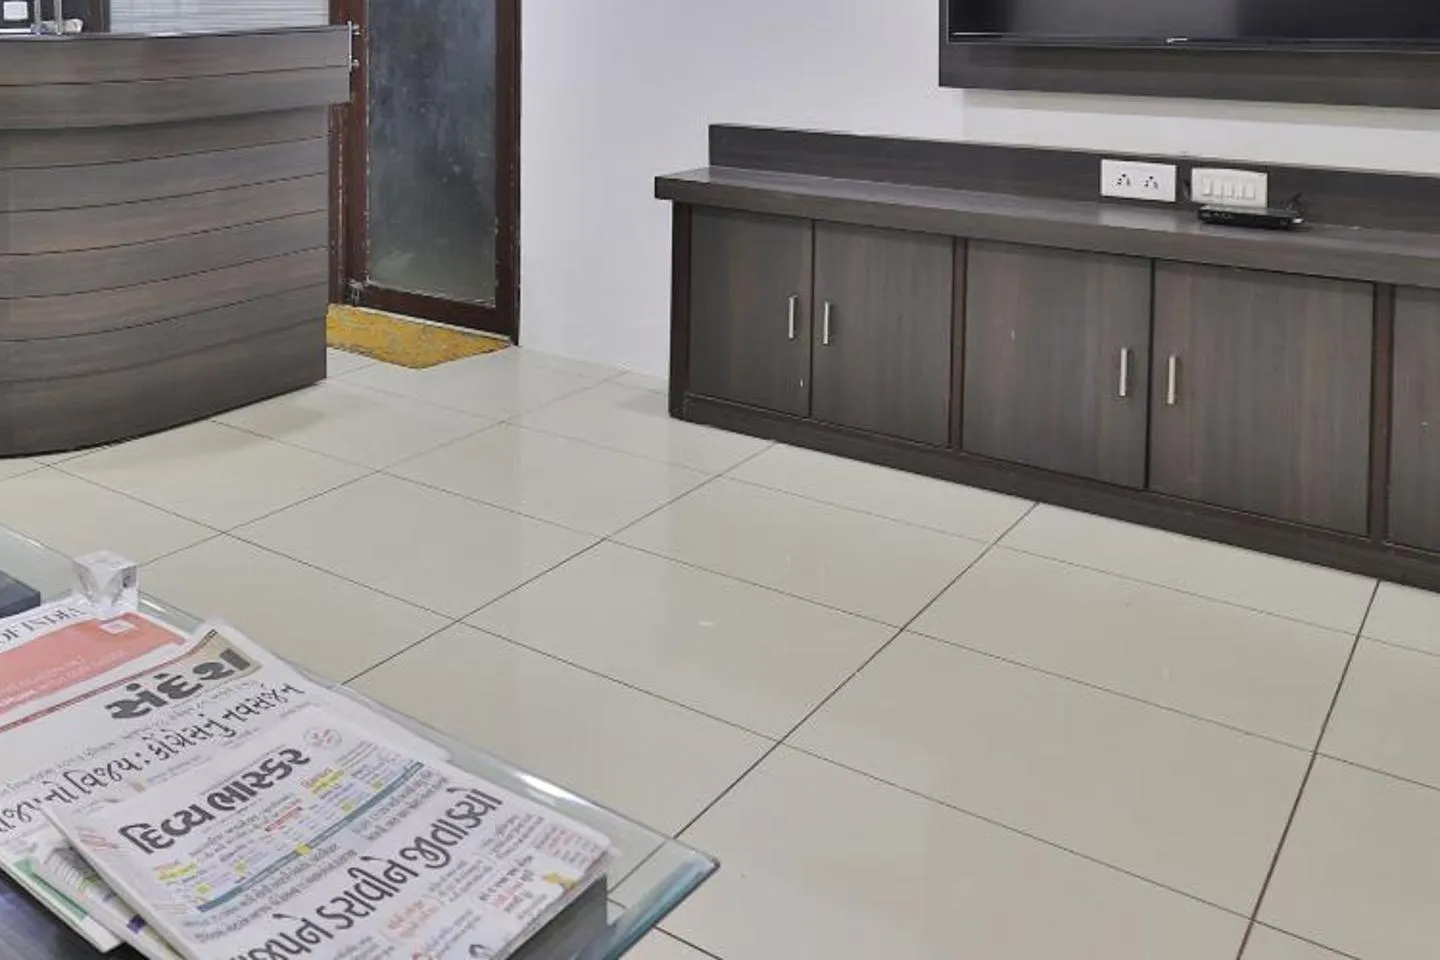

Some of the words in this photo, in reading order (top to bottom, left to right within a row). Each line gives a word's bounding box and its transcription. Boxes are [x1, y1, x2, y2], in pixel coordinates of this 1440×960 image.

[18, 607, 86, 636] INDIA
[104, 648, 250, 719] સંદેશ
[118, 801, 215, 855] દિવ્ય
[207, 748, 311, 813] ભાસ્કર
[316, 855, 420, 930] ડરાવીને
